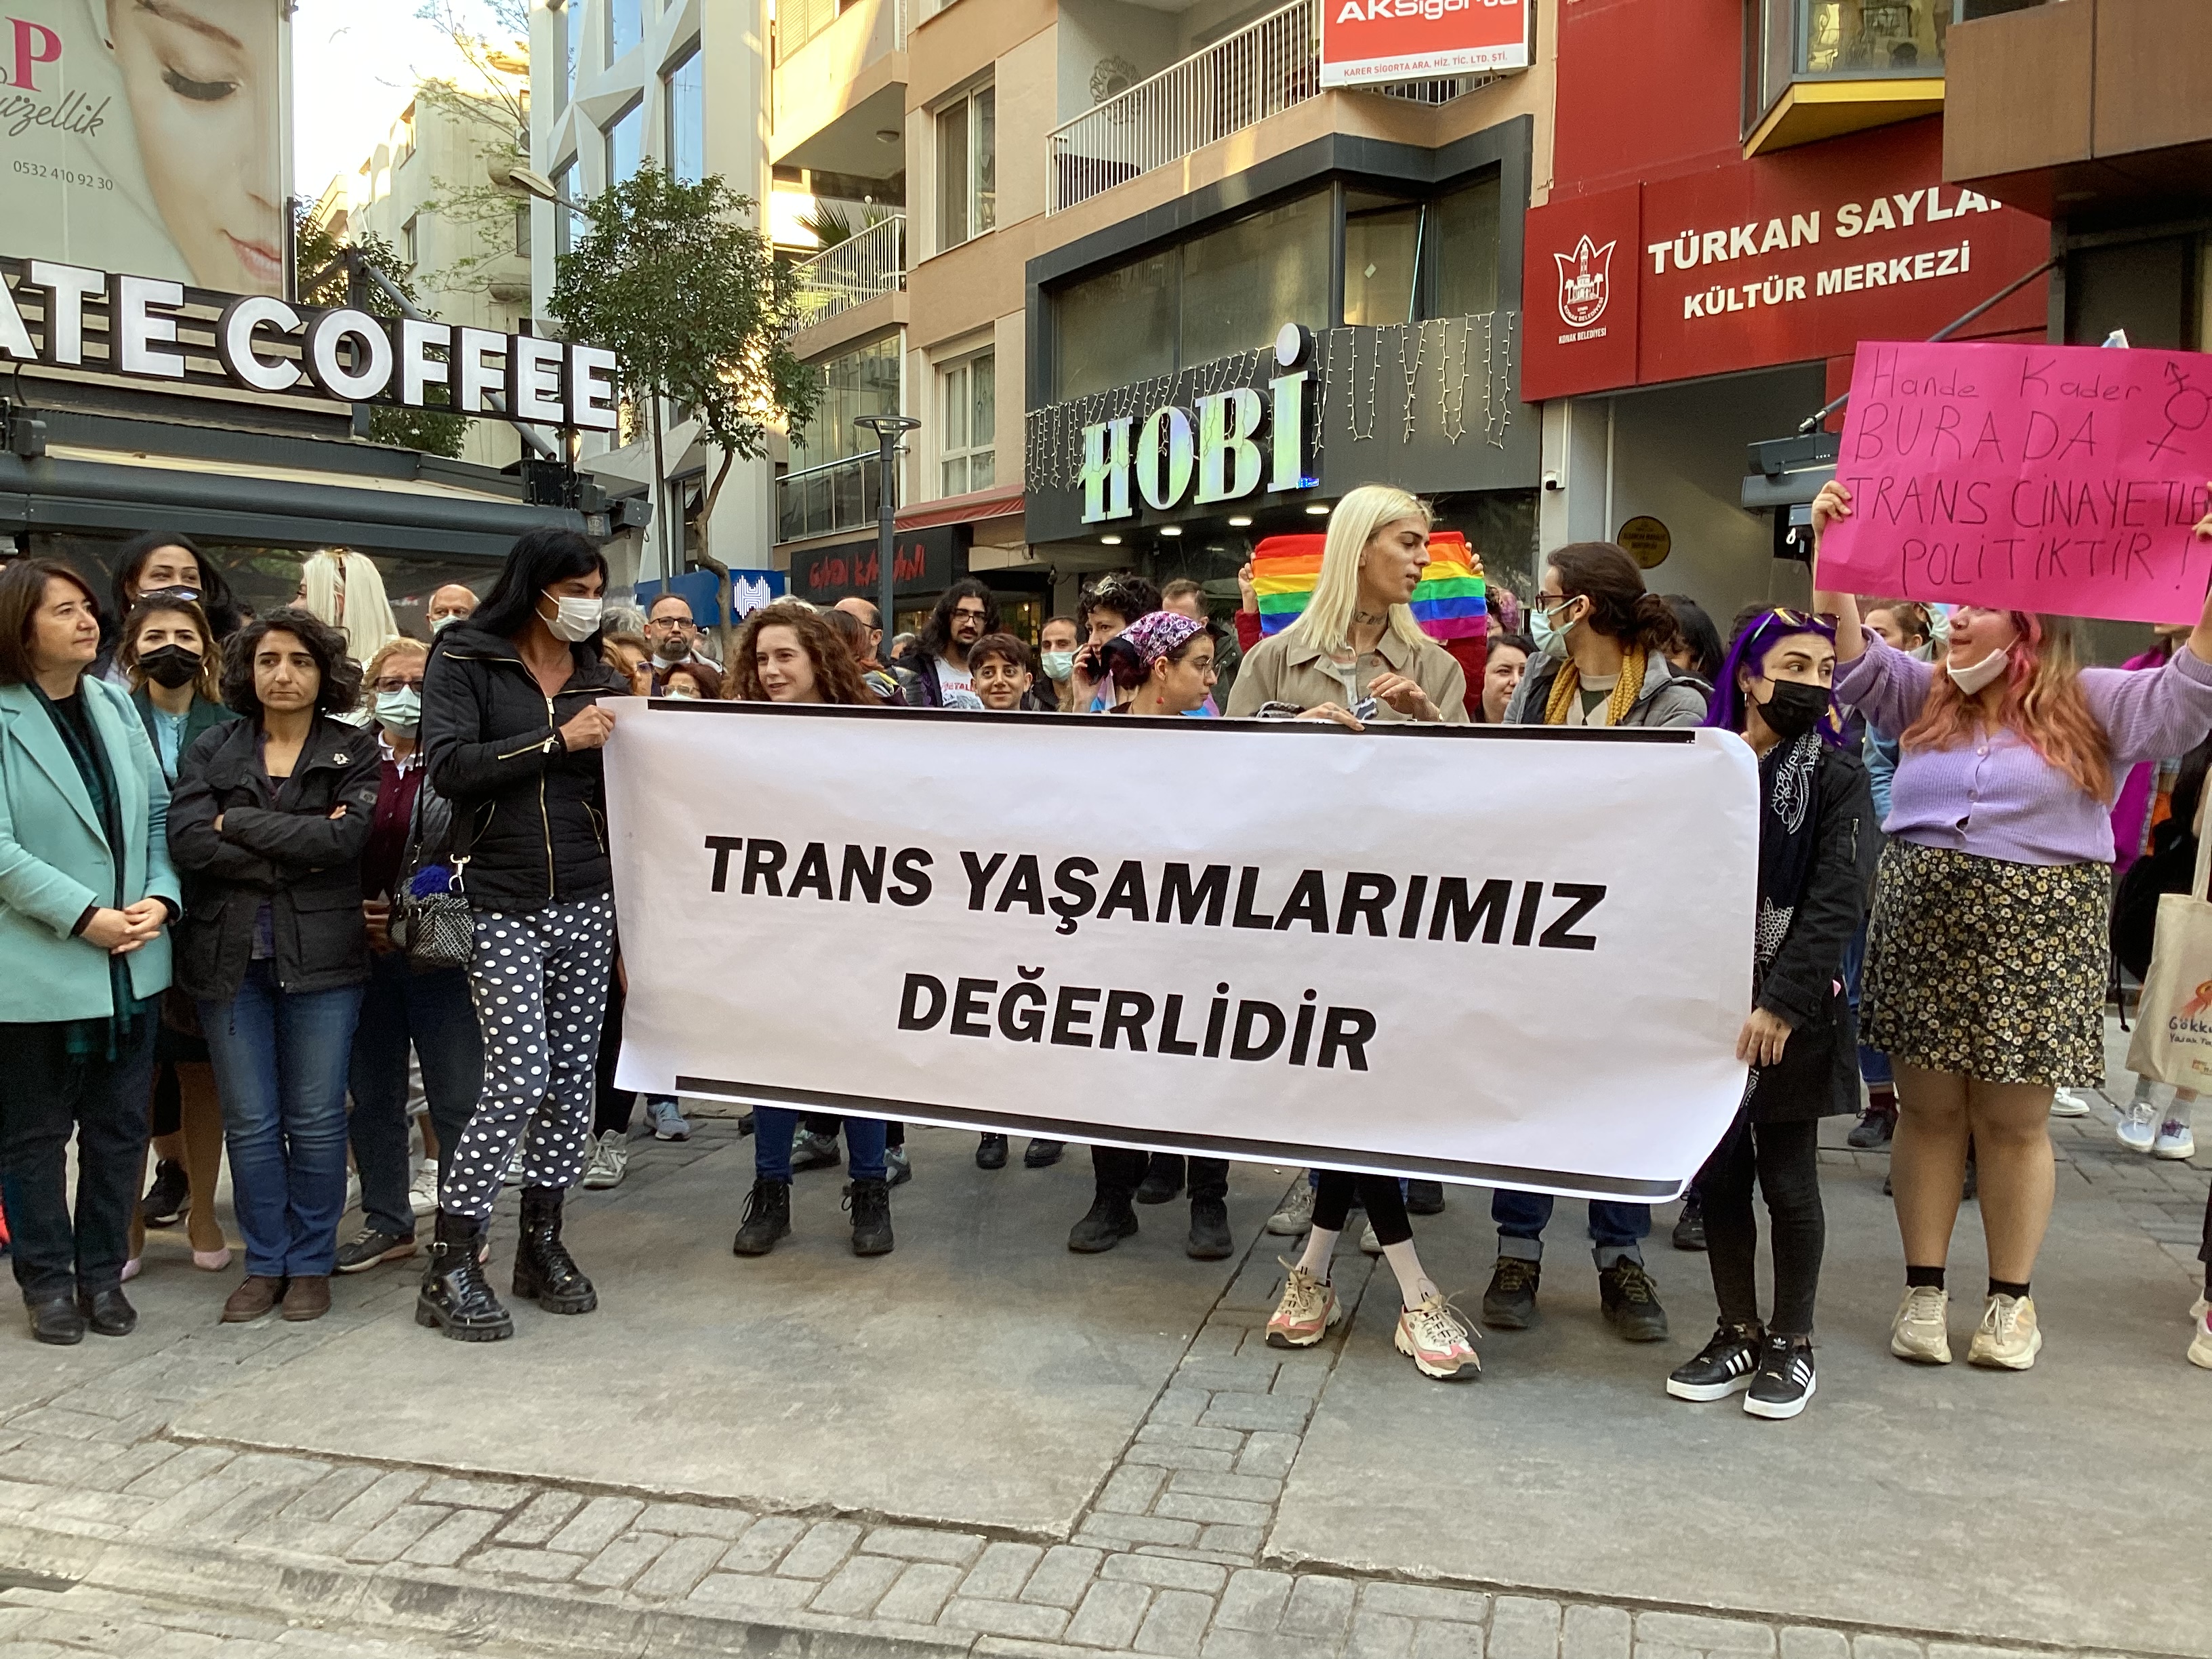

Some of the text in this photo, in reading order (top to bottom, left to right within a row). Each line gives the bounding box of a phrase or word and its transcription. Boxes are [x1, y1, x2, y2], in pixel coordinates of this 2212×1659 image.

[5, 16, 62, 92] P
[1344, 51, 1508, 77] KARER SİGORTA ARA. HİZ. TİC. LTD. ŞTİ.
[14, 161, 113, 190] 0532 410 92 30
[1647, 186, 2002, 274] TÜRKAN SAYLA
[1684, 241, 1970, 319] KÜLTÜR MERKEZİ
[225, 295, 617, 431] COFFEE
[1559, 333, 1577, 344] KONAK
[1871, 348, 2142, 402] Hande Kader
[1077, 323, 1309, 524] HOBİ
[1854, 403, 2097, 464] BURADA
[1846, 476, 1990, 525] TRANS
[705, 836, 1606, 950] TRANS YAŞAMLARIMIZ
[898, 966, 1376, 1071] DEĞERLİDİR
